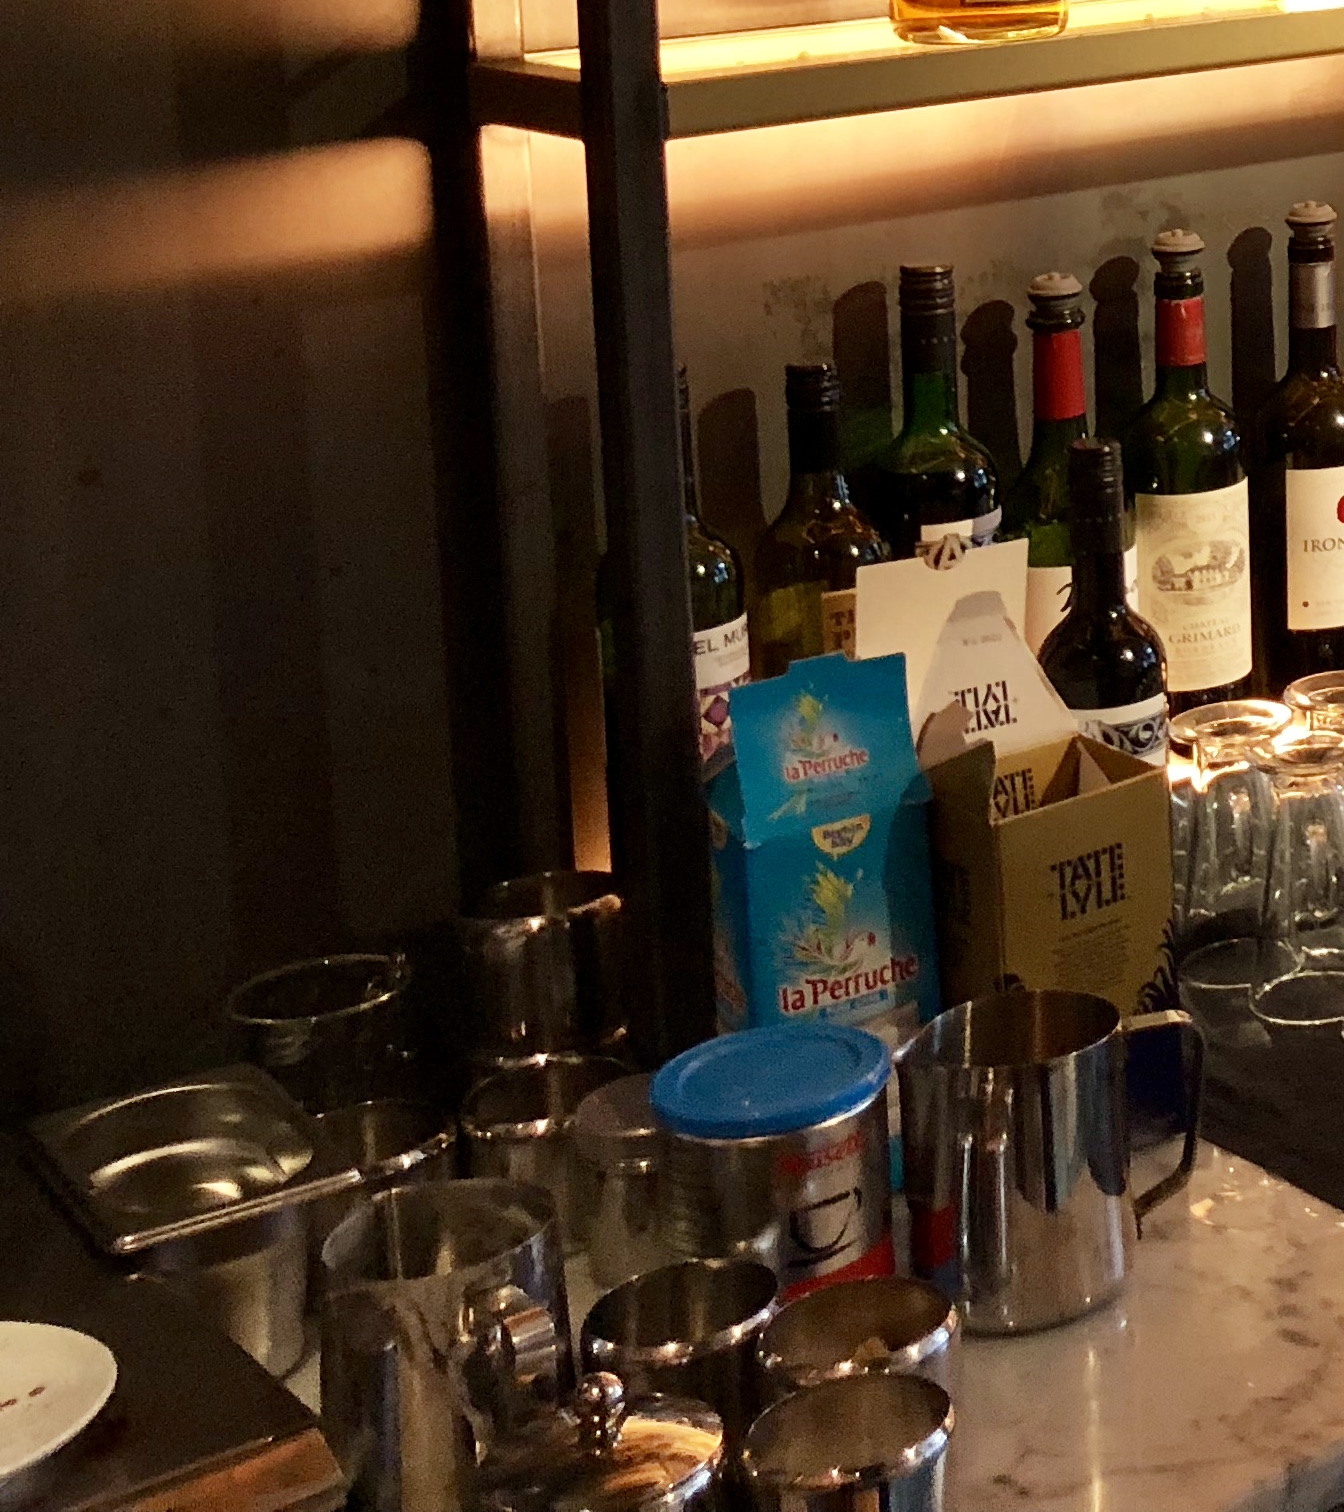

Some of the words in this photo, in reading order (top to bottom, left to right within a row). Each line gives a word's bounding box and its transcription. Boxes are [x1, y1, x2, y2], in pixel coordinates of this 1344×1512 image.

[785, 764, 801, 782] la
[800, 748, 868, 778] Perruche
[1050, 842, 1125, 889] TATE
[1060, 868, 1126, 922] LYLE
[782, 986, 806, 1013] la
[805, 954, 918, 1006] Perruche
